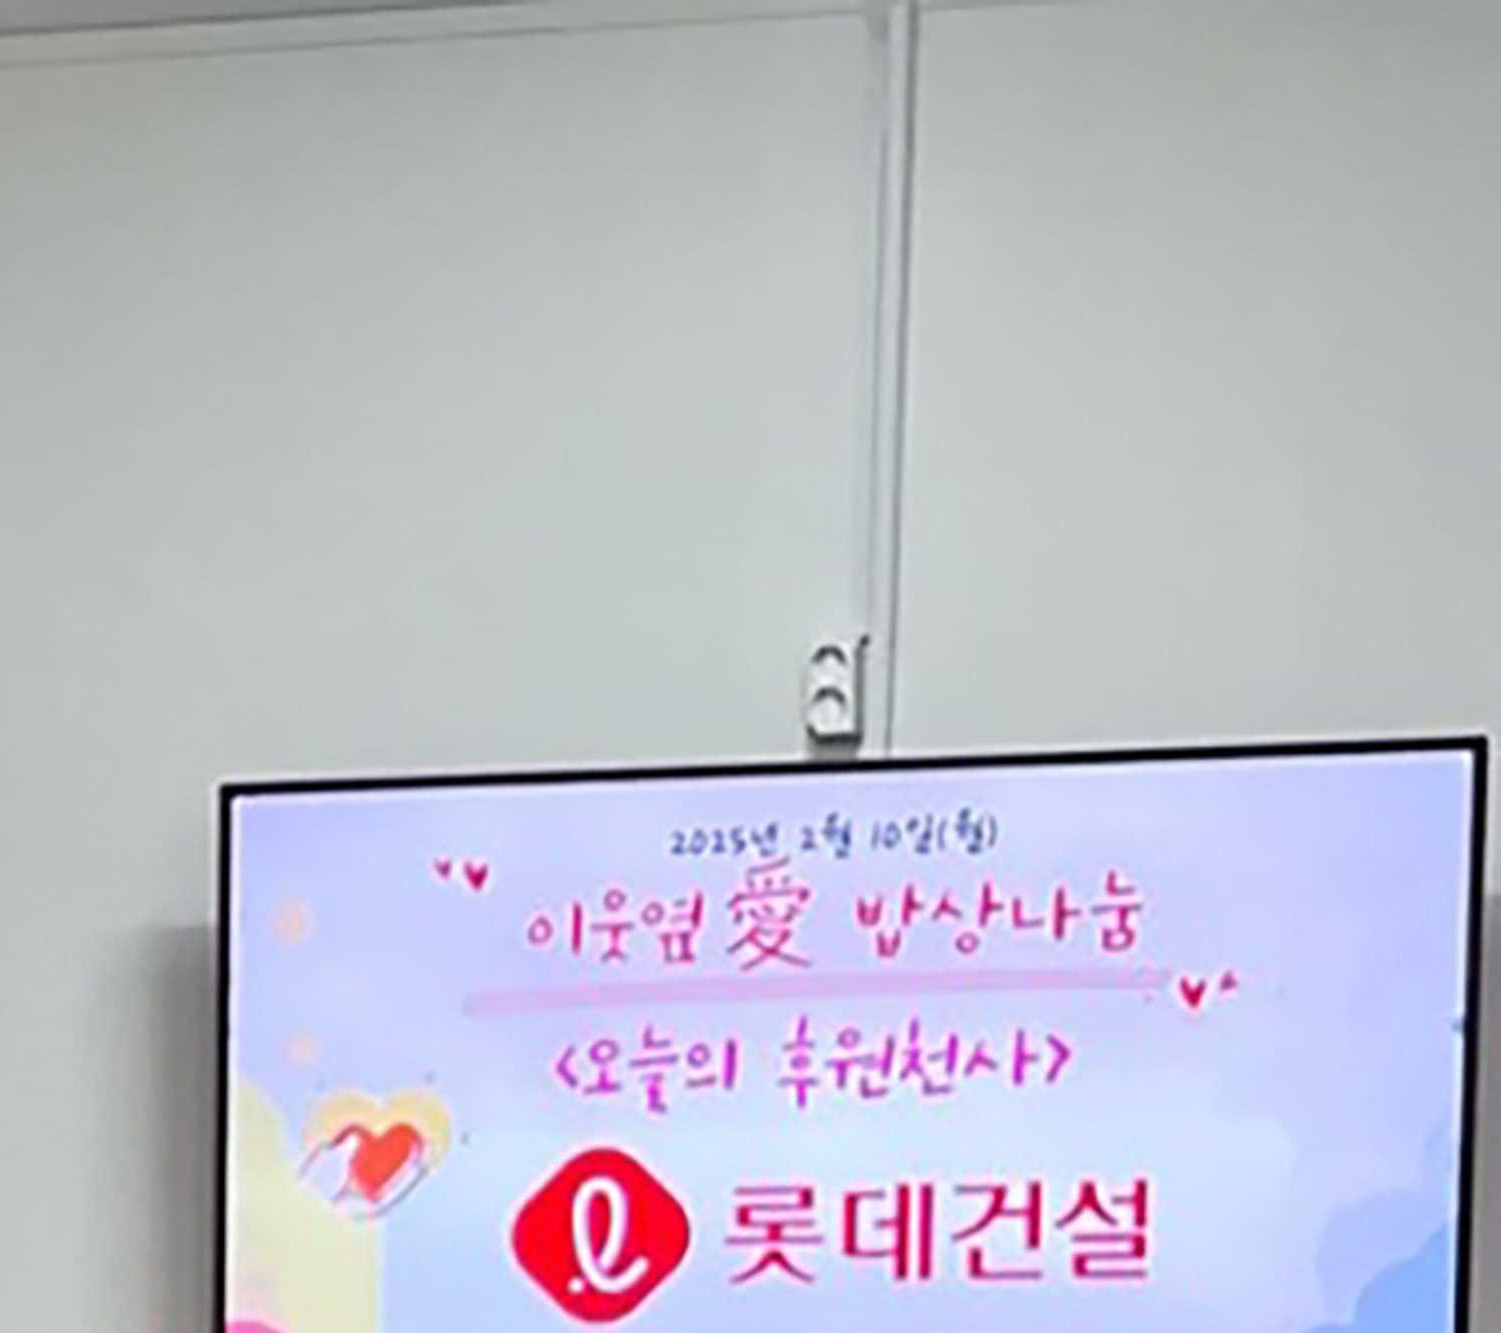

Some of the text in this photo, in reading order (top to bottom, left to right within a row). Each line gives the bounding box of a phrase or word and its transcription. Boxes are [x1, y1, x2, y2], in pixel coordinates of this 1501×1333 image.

[669, 821, 779, 856] 2025년
[801, 812, 852, 859] 2월
[856, 871, 1144, 958] 밥상나눔
[724, 1178, 1148, 1285] 롯데건설
